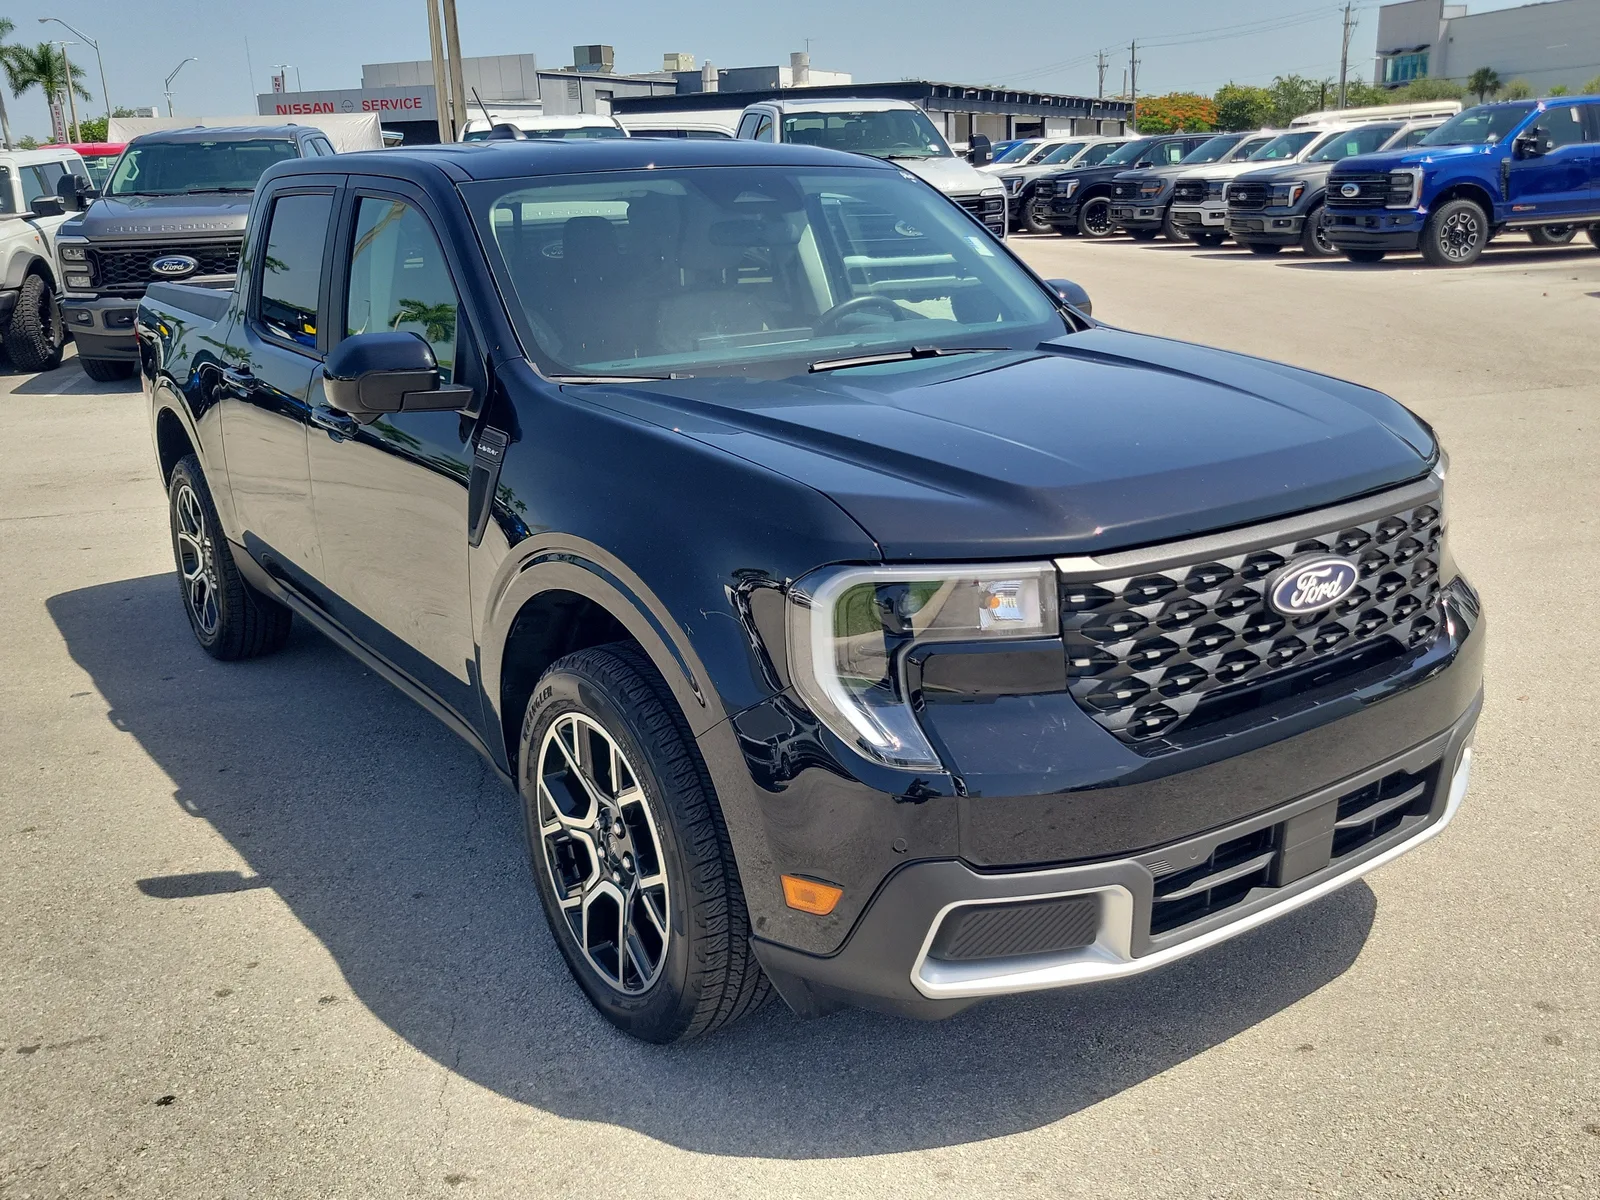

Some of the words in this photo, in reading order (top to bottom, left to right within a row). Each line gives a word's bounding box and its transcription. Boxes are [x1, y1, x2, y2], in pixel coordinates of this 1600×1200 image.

[276, 102, 335, 115] NISSAN
[362, 97, 422, 111] SERVICE
[53, 105, 65, 144] ENTRANC
[161, 261, 185, 271] Ford
[1290, 567, 1344, 608] Ford
